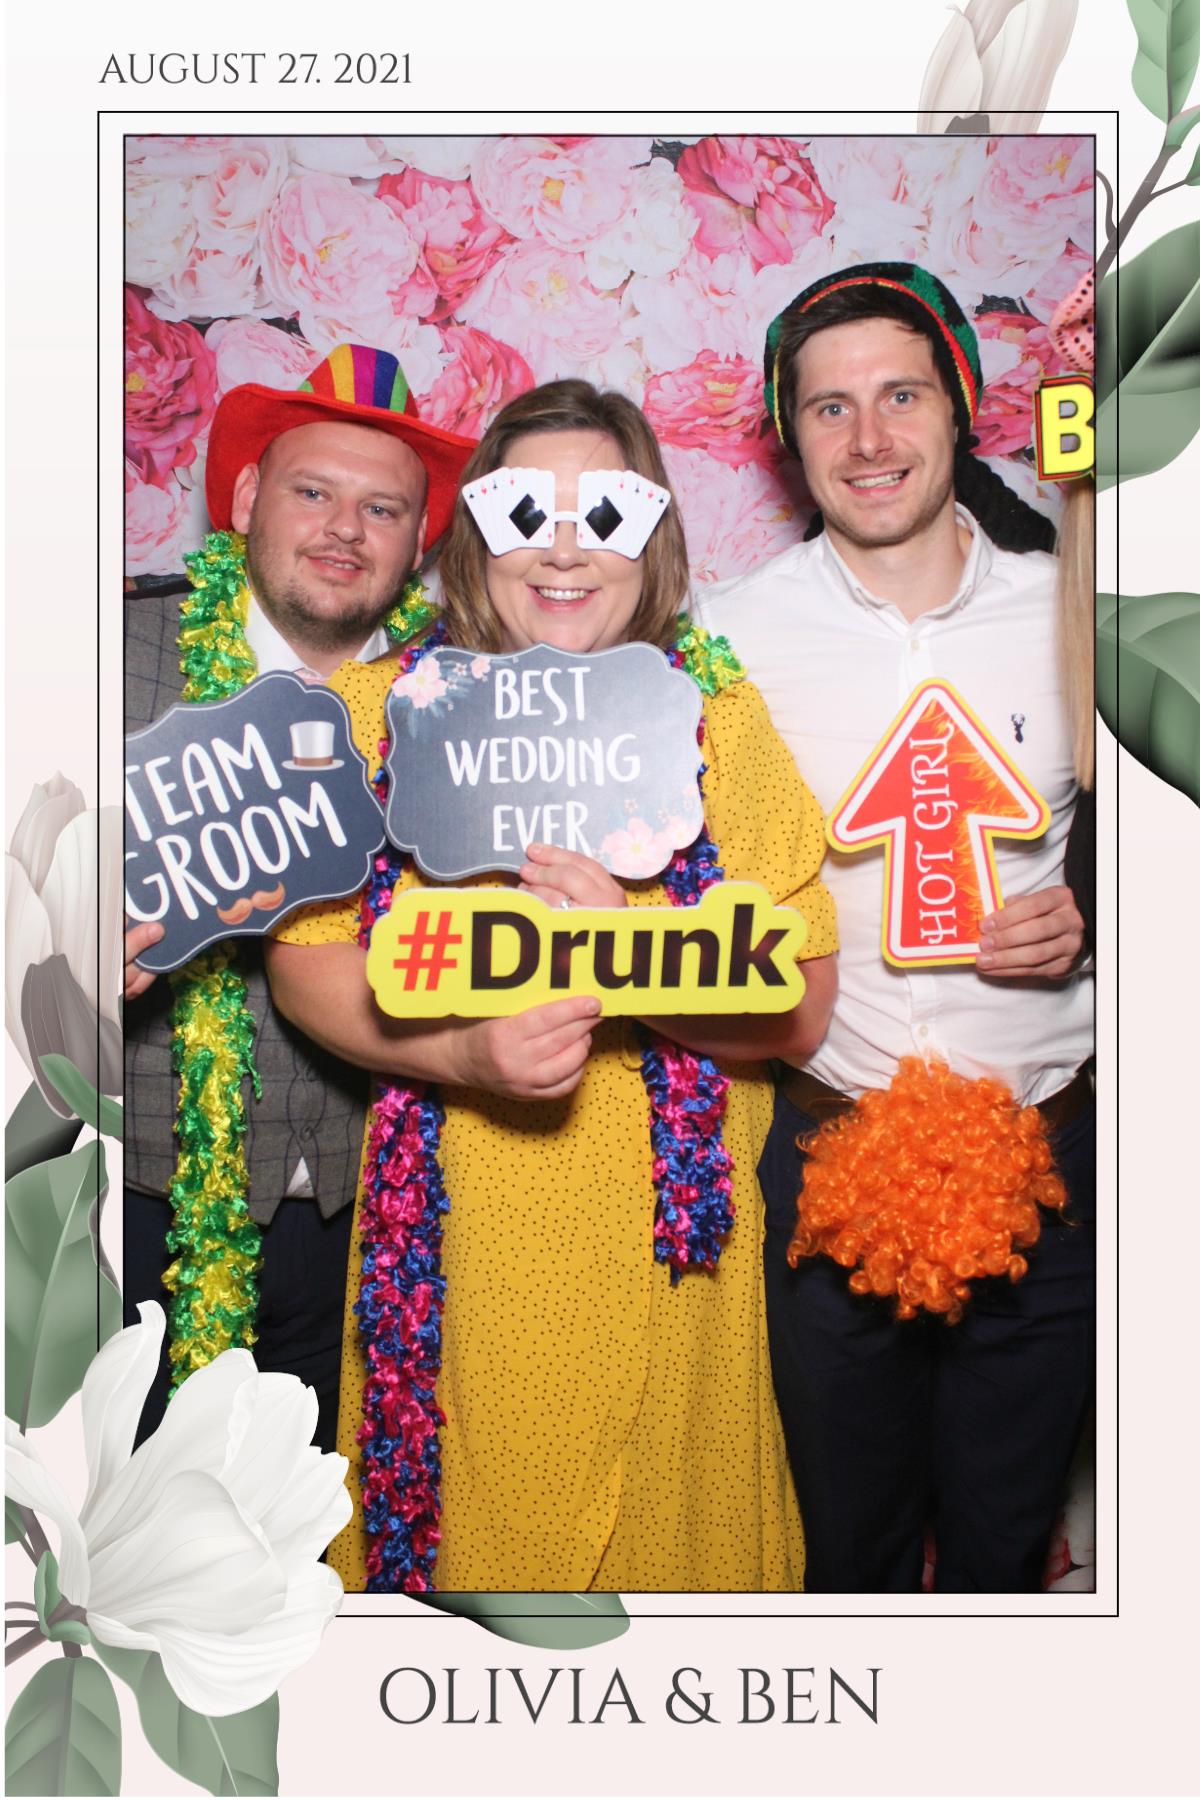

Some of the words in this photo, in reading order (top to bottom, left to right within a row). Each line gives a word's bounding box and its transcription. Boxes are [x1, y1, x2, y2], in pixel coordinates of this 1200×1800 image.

[494, 666, 591, 726] BEST
[126, 723, 282, 842] TEAM
[444, 734, 641, 788] WEDDING
[909, 722, 959, 831] GIRL
[126, 781, 347, 921] GROOM
[492, 801, 593, 856] EVER
[914, 841, 958, 945] HOT
[393, 903, 791, 991] #Drunk
